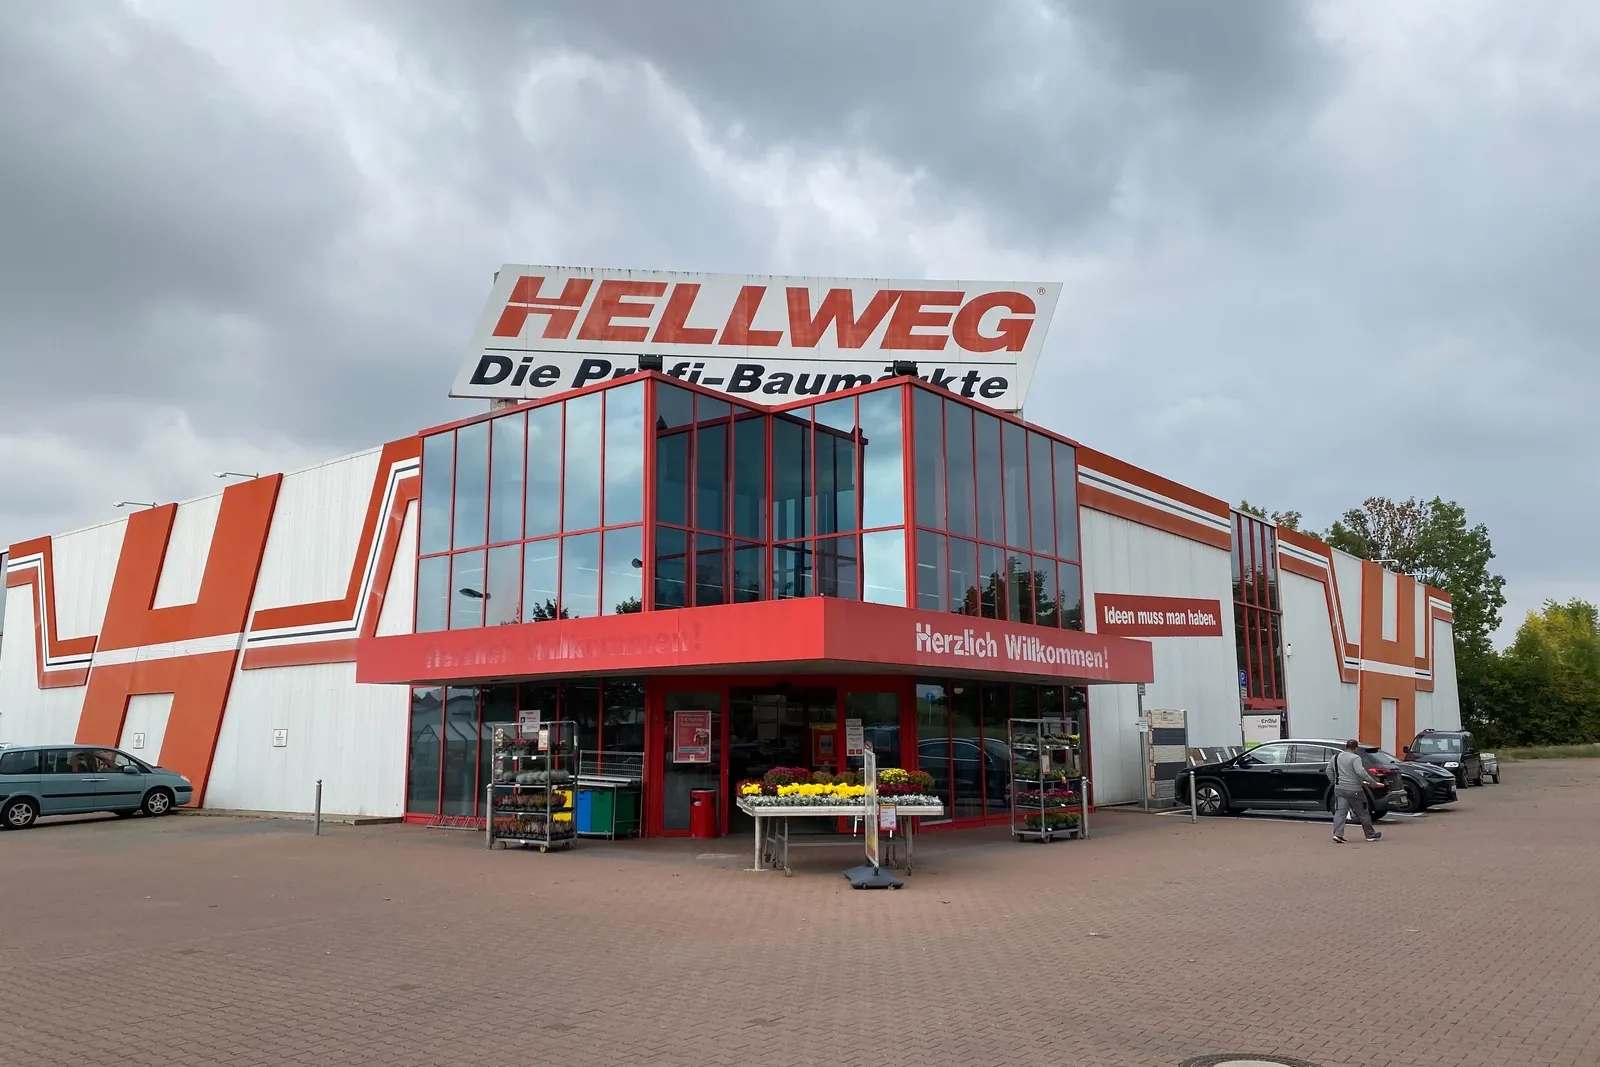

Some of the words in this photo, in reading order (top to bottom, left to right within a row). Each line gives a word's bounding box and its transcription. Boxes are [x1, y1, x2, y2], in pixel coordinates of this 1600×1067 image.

[492, 276, 1036, 352] HELLWEG
[469, 354, 561, 388] Die
[1104, 606, 1135, 625] Ideen
[1137, 611, 1164, 625] muss
[1166, 612, 1186, 625] man
[1188, 609, 1217, 626] haben.
[916, 622, 998, 658] Herzlich
[1004, 633, 1109, 670] Willkommen!
